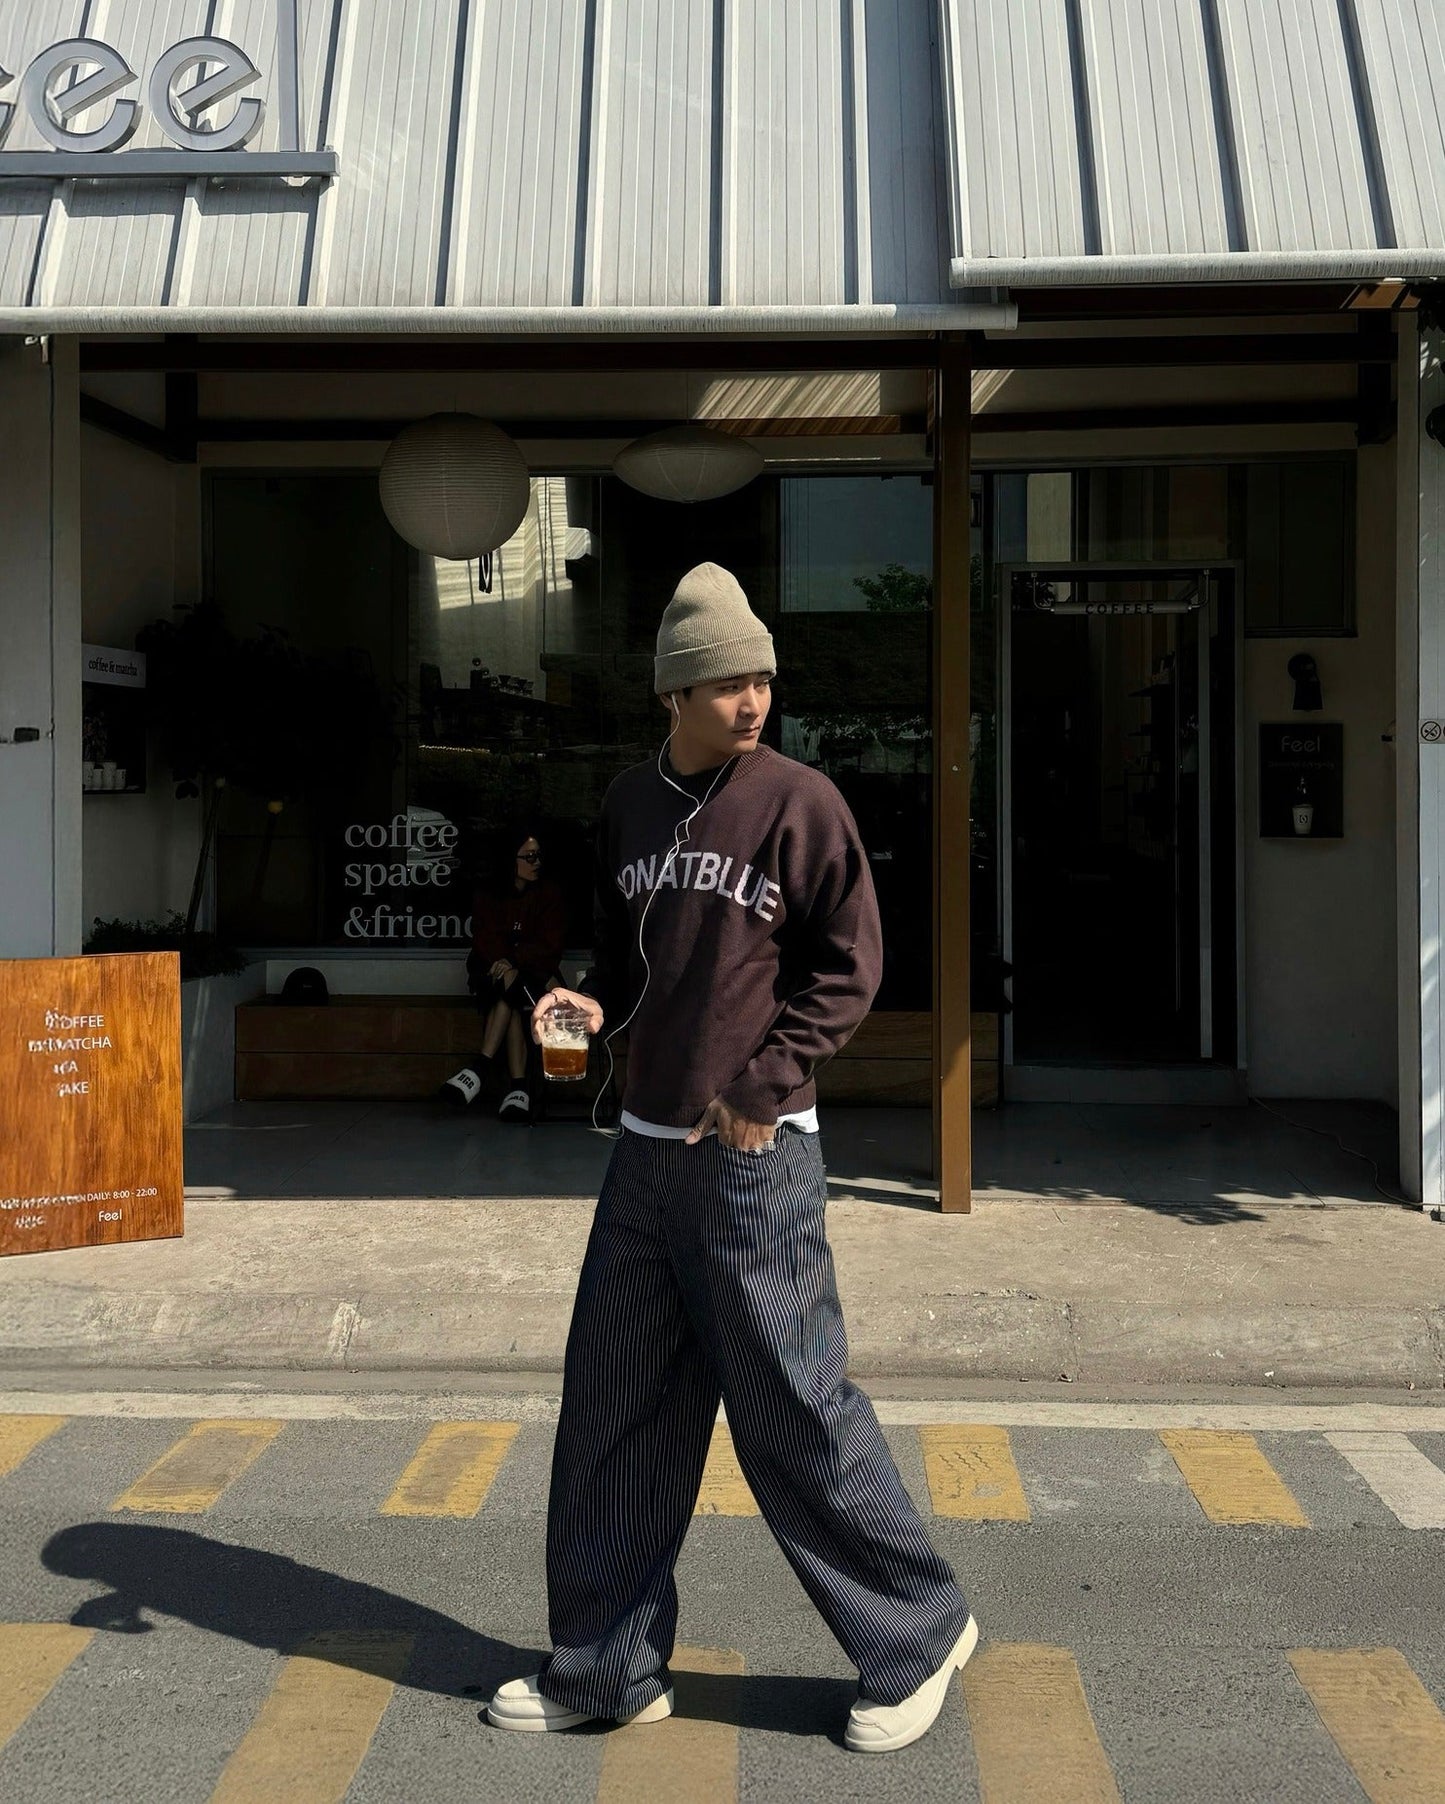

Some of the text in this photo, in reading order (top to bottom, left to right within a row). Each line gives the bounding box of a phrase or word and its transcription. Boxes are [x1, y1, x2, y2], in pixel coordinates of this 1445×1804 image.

[0, 0, 305, 153] eel
[1085, 603, 1155, 615] COFFEE
[88, 656, 108, 673] coffee
[344, 814, 459, 848] coffee
[344, 862, 451, 896] space
[87, 1192, 112, 1202] DAILY:
[112, 1190, 130, 1199] 8:00
[136, 1187, 158, 1197] 22:00
